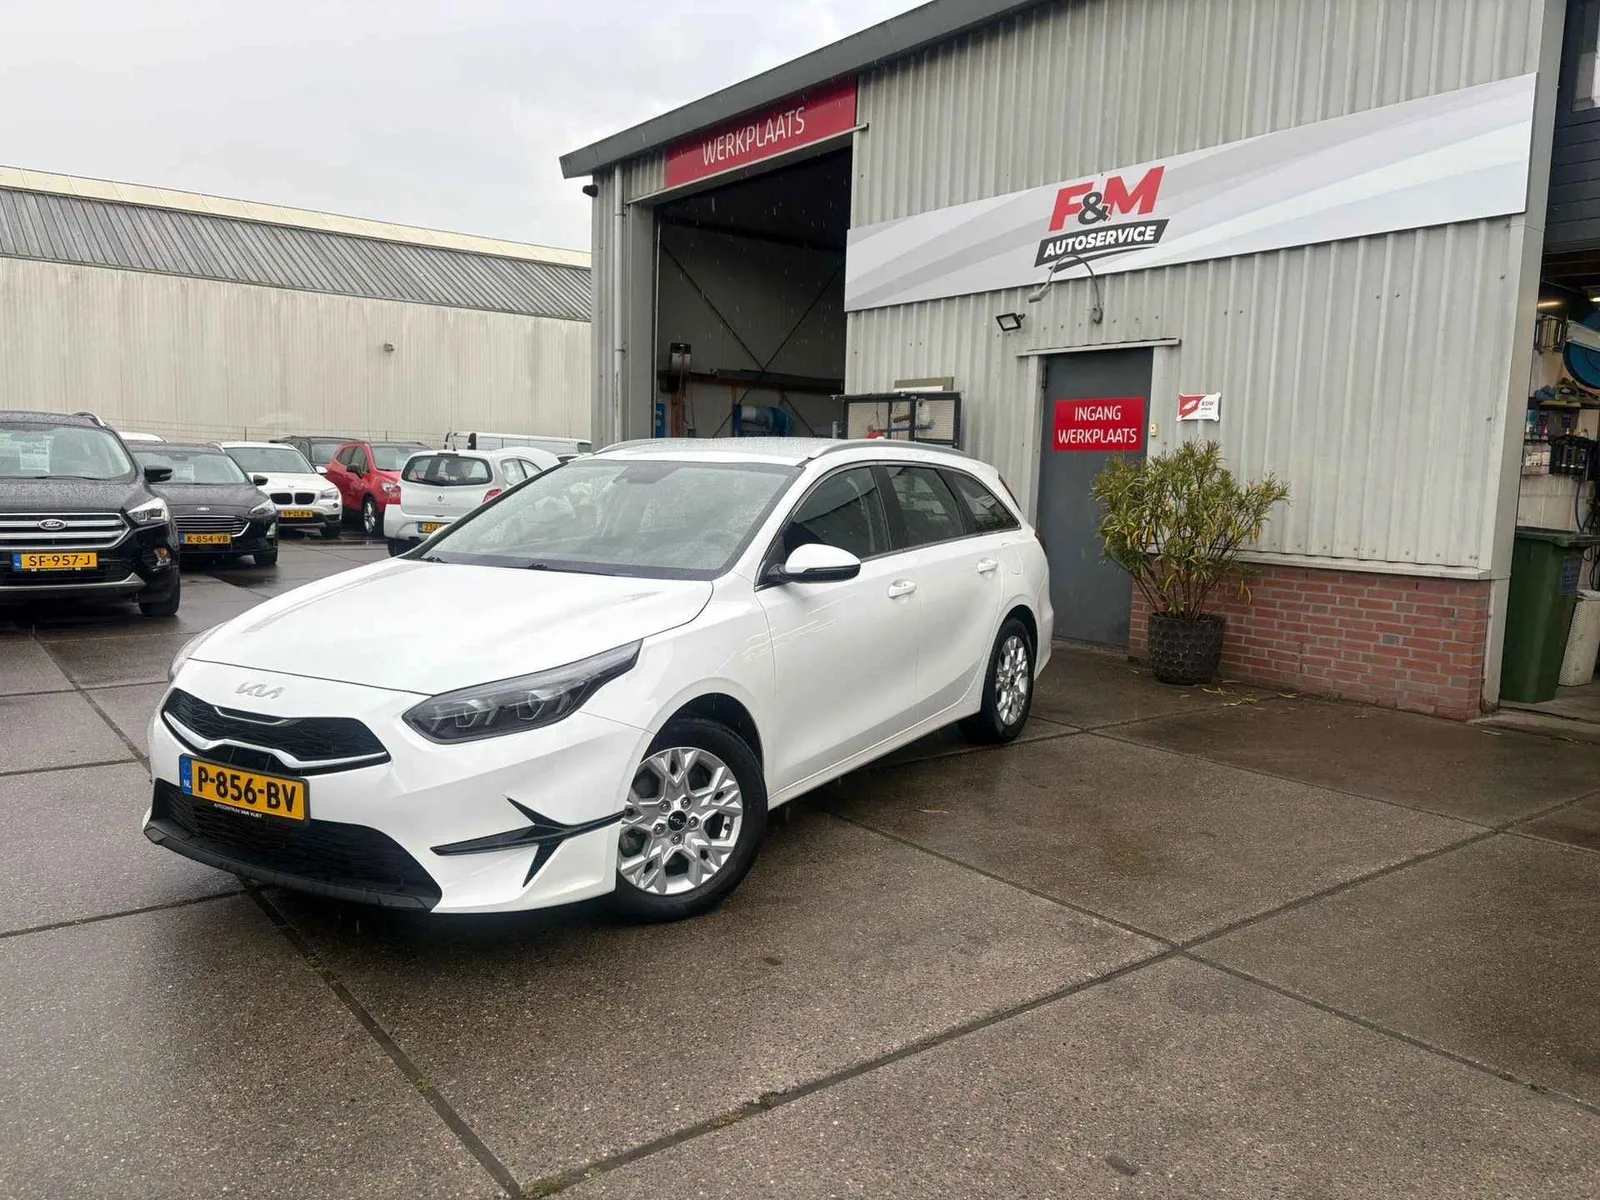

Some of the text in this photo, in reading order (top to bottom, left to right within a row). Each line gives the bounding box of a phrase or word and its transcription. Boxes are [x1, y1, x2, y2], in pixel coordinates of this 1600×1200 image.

[702, 106, 805, 166] WERKPLAATS
[1048, 166, 1165, 231] F&M
[1043, 225, 1157, 258] AUTOSERVICE
[1074, 405, 1123, 422] INGANG
[1058, 427, 1137, 445] WERKPLAATS
[187, 535, 230, 543] K-854-VB
[28, 554, 91, 567] SF-957-J
[235, 681, 286, 700] KIA
[197, 766, 297, 813] P-856-BV
